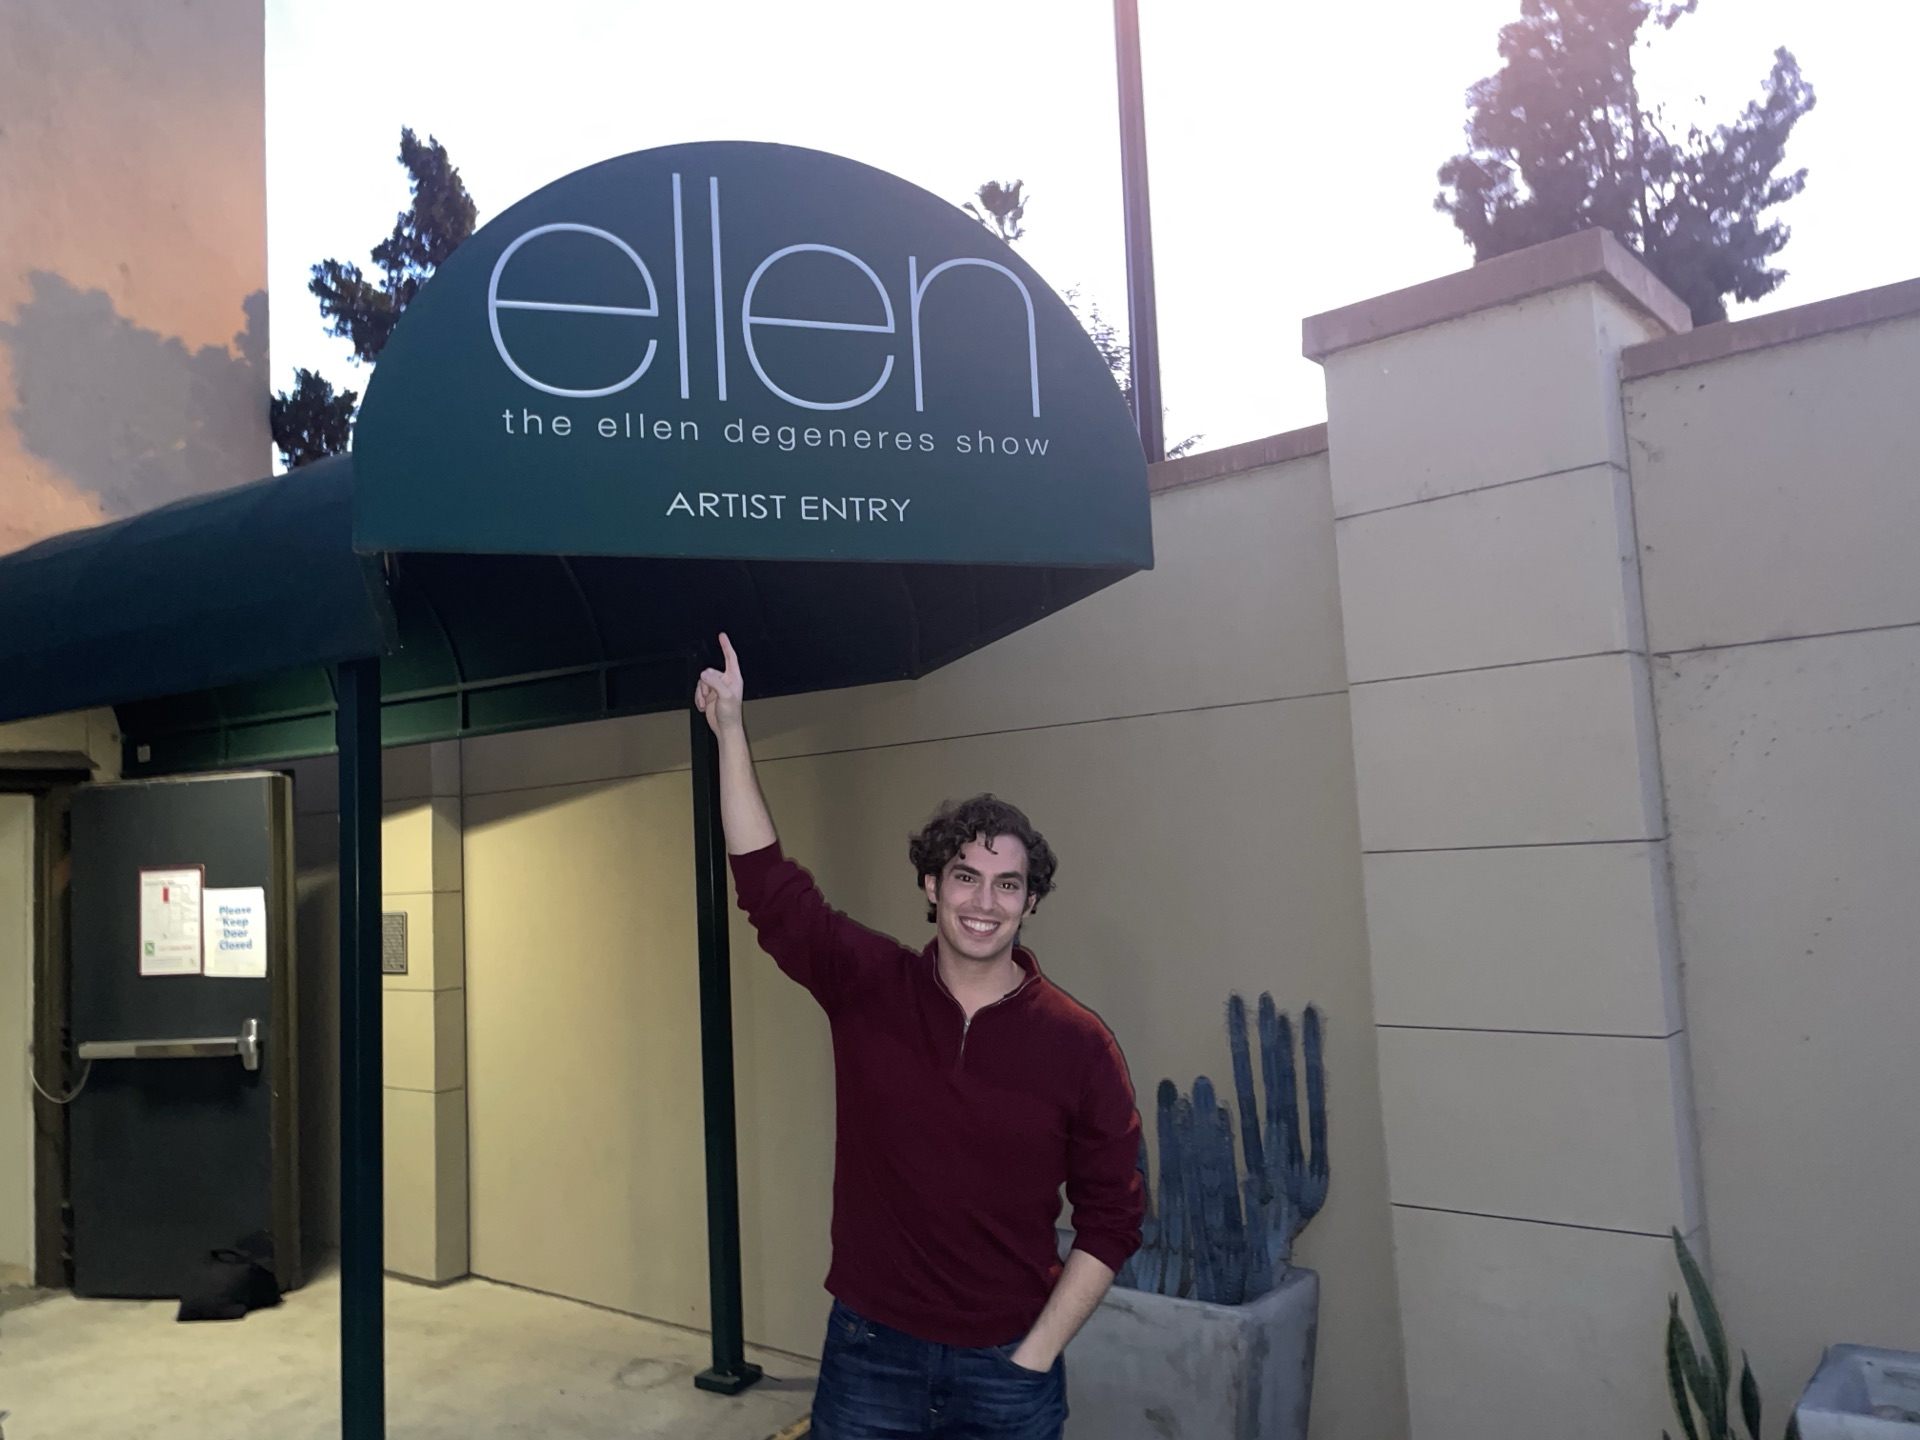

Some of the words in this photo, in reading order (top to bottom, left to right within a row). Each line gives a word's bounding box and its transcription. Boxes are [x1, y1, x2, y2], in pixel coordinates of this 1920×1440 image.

[487, 173, 1040, 418] ellen
[502, 408, 572, 436] the
[597, 412, 699, 441] ellen
[723, 417, 935, 452] degeneres
[956, 430, 1051, 457] show
[666, 492, 787, 520] ARTIST
[801, 496, 912, 523] ENTRY
[219, 905, 252, 915] Please
[223, 918, 249, 928] Keep
[223, 929, 248, 938] Door
[219, 939, 253, 950] Closed
